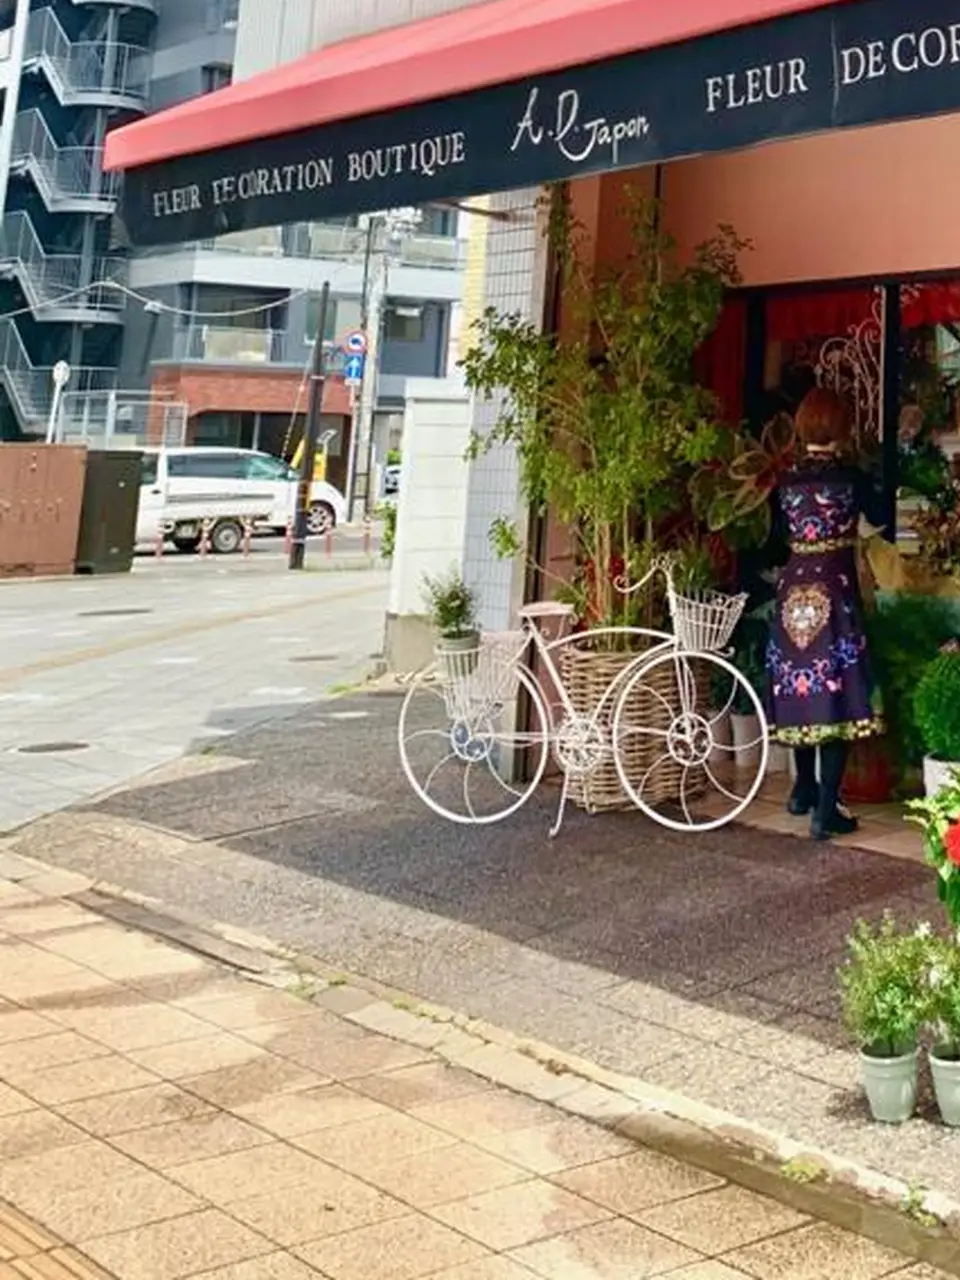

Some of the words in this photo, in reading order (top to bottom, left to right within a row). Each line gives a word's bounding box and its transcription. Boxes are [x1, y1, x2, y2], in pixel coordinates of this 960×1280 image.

[153, 183, 202, 217] FLEUR
[348, 131, 466, 178] BOUTIQUE
[705, 56, 809, 113] FLEUR
